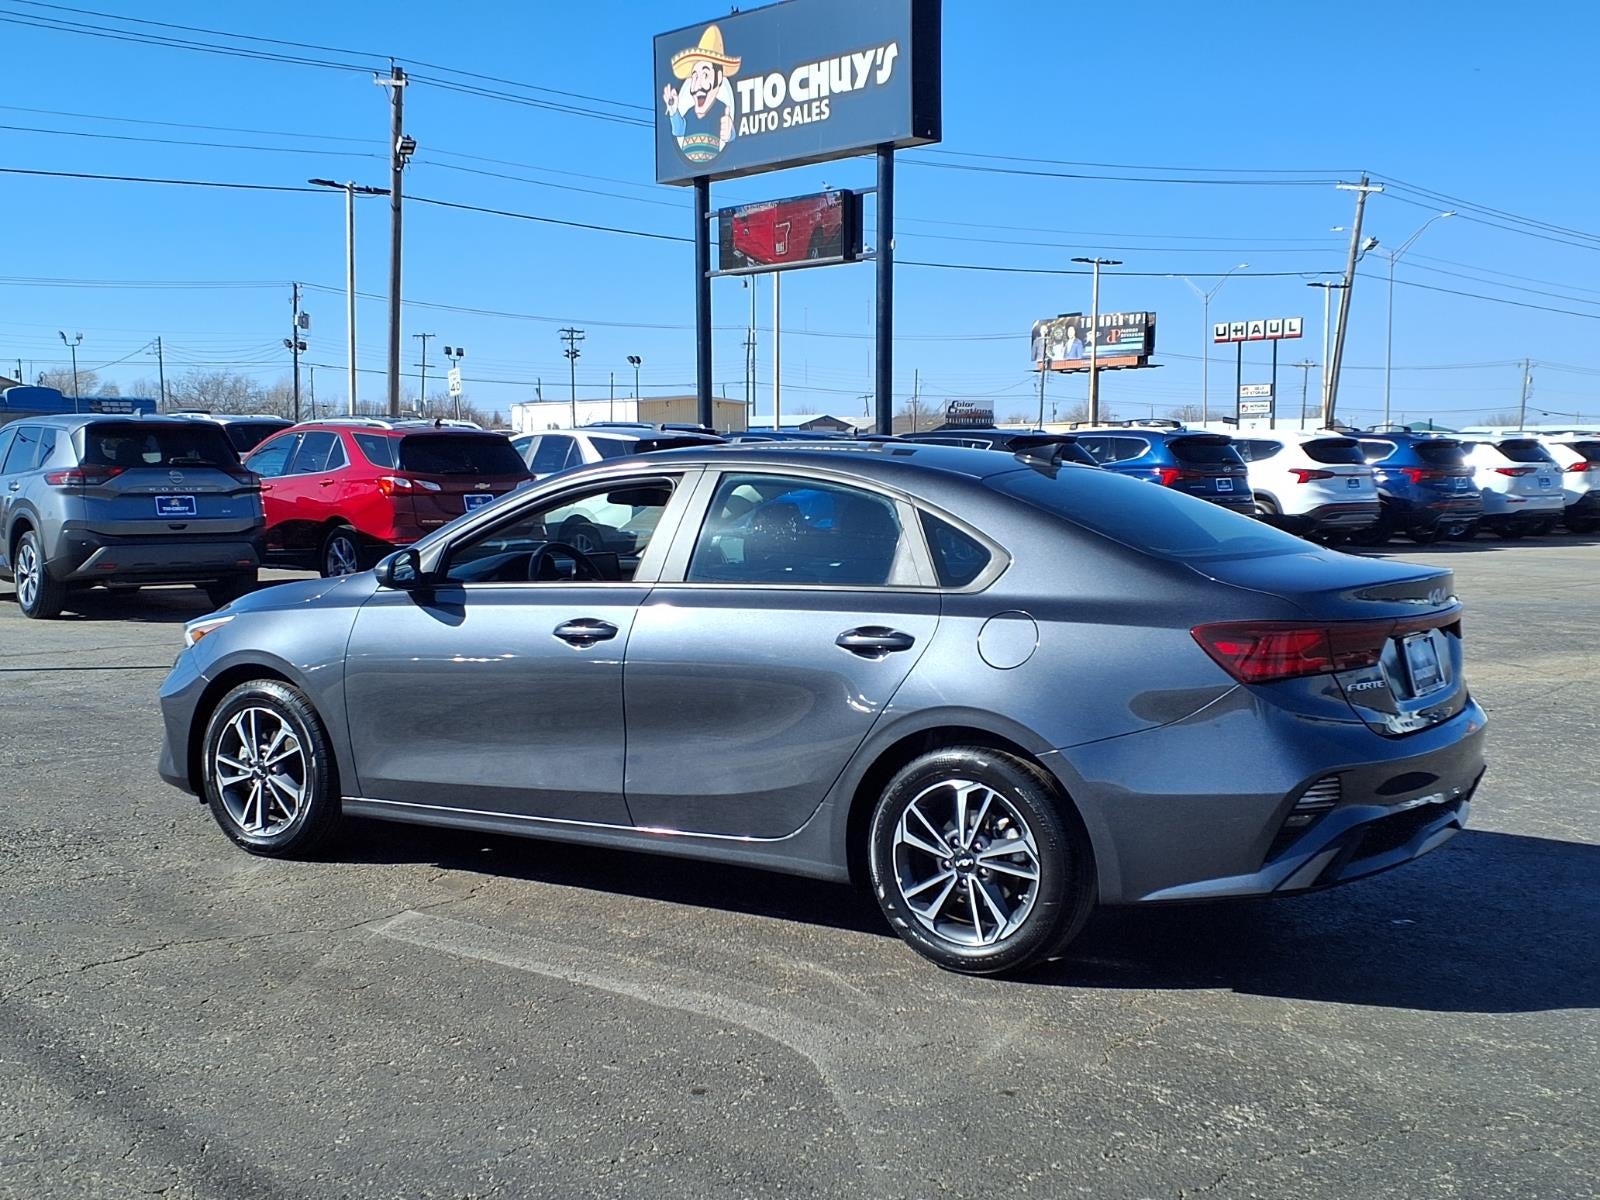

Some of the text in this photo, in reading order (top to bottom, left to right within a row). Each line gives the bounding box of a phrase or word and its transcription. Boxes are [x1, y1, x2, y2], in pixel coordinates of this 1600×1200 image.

[737, 42, 898, 114] TIO CHUY'S
[738, 98, 830, 136] AUTO SALES
[450, 381, 460, 391] 40
[1346, 679, 1386, 692] FORTE
